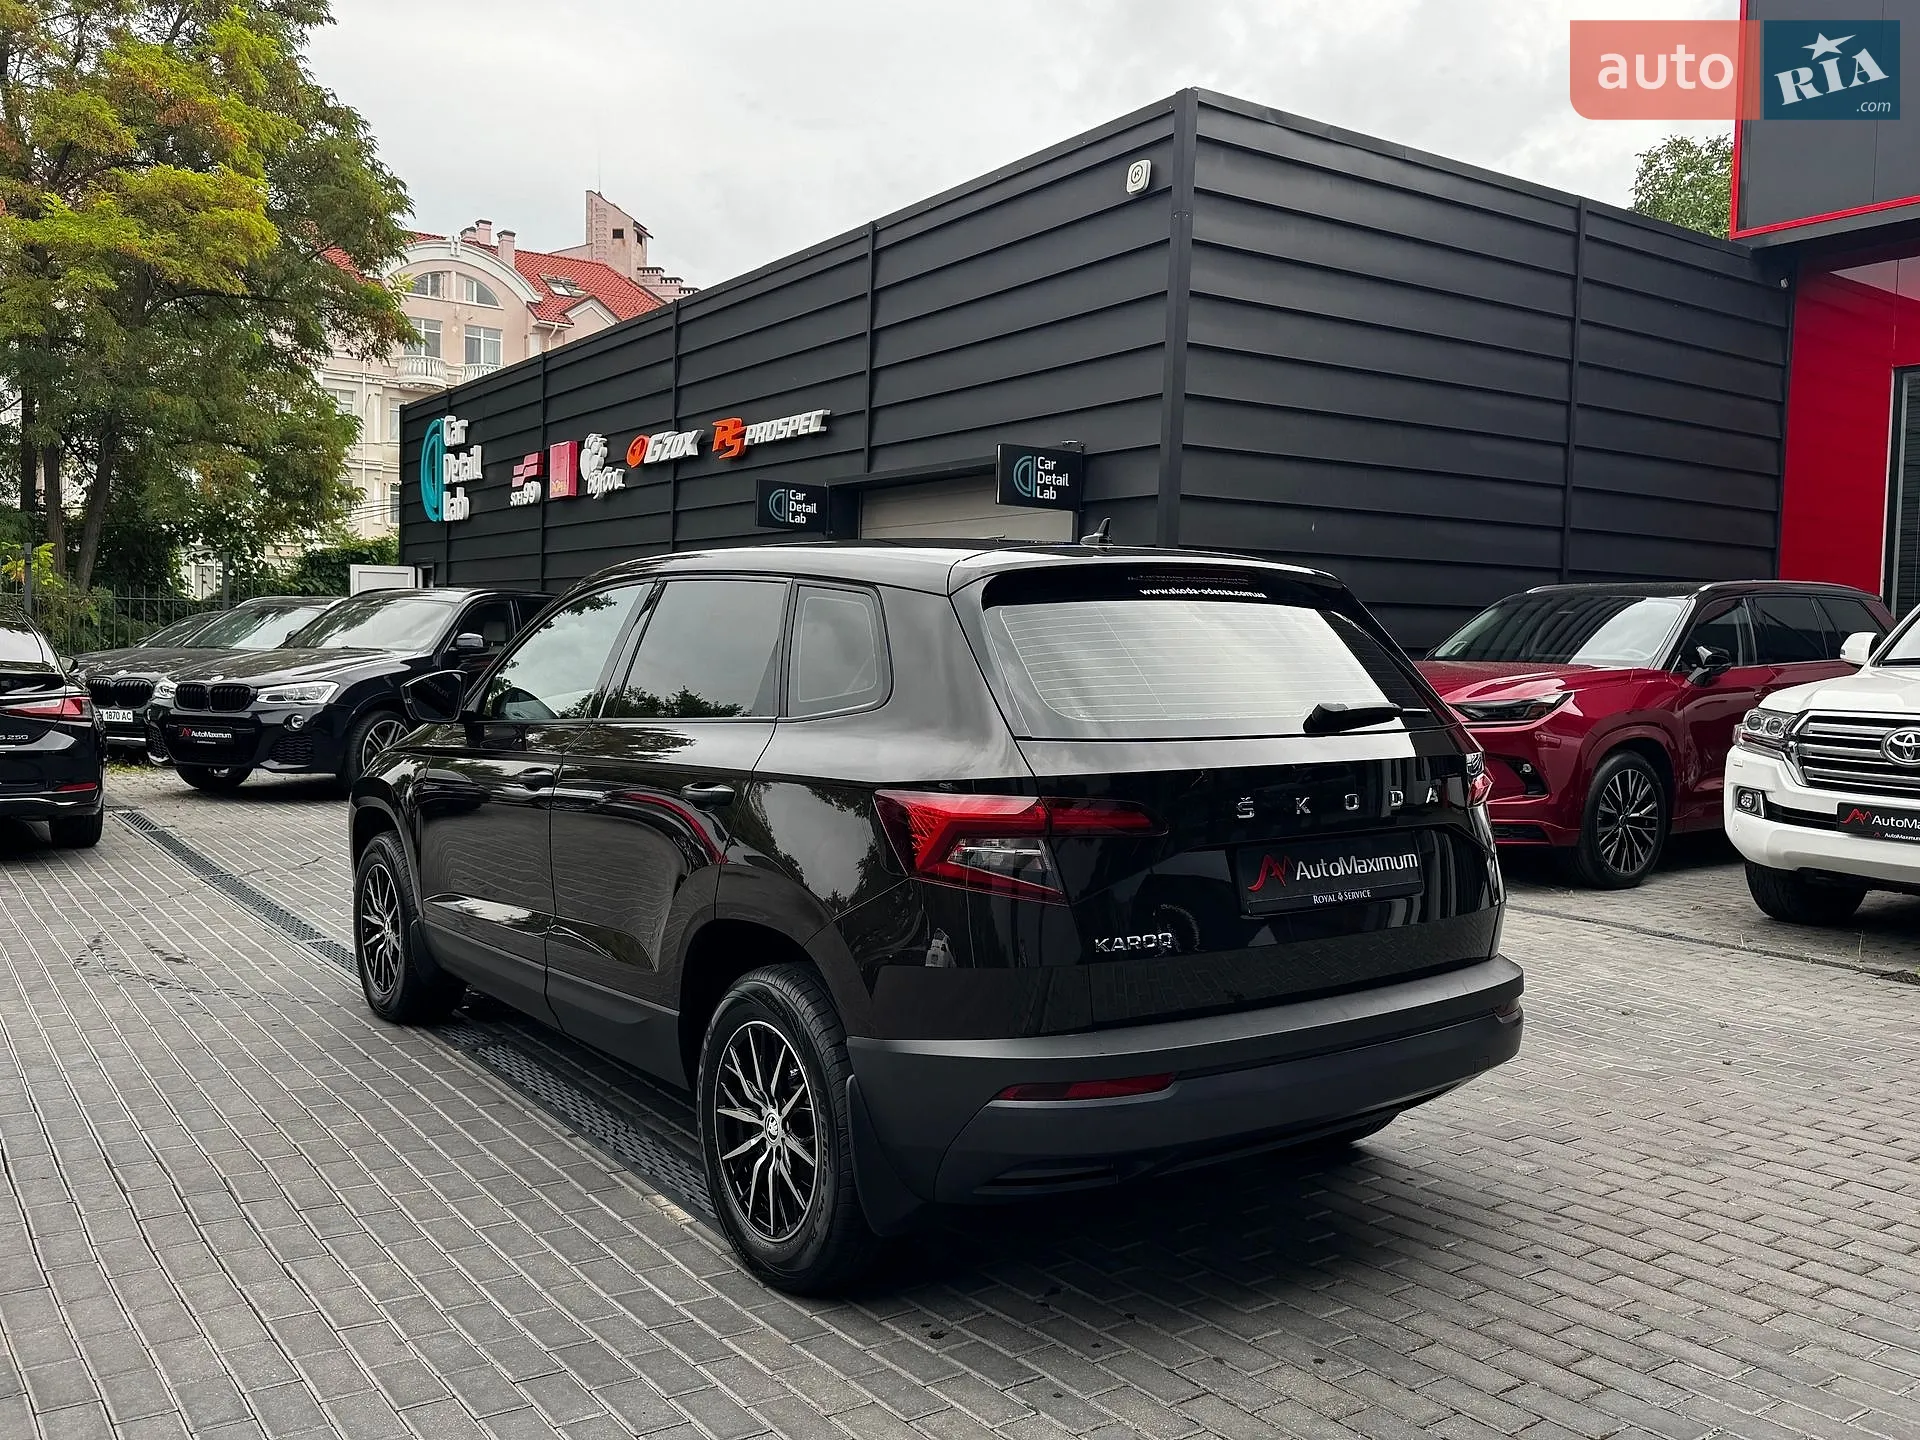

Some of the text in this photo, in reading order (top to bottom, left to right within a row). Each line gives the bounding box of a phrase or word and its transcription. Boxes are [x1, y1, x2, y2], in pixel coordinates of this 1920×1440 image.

[443, 415, 468, 446] Car
[744, 409, 831, 446] PROSPEC
[443, 445, 482, 484] Detail
[1037, 456, 1056, 470] Car
[1037, 471, 1069, 487] Detail
[789, 489, 806, 500] Car
[1036, 486, 1057, 500] Lab
[443, 487, 469, 521] Lab
[789, 501, 817, 513] Detail
[789, 512, 806, 524] Lab
[122, 711, 132, 720] AC
[1236, 787, 1439, 819] ŠKODA
[1296, 853, 1418, 881] AutoMaximum
[1313, 889, 1371, 905] ROYAL SERVICE
[1095, 932, 1172, 953] KAROQ
